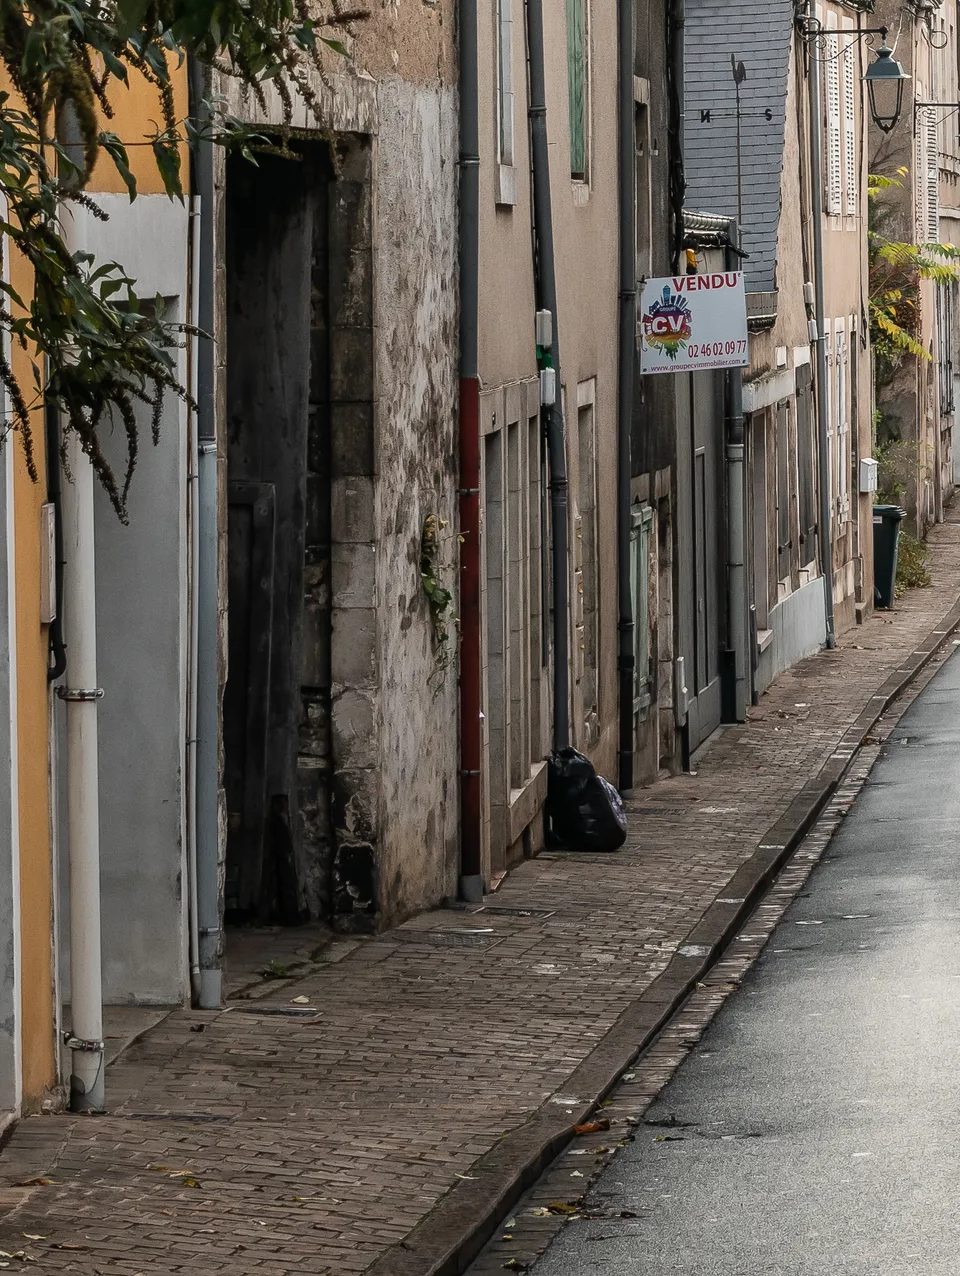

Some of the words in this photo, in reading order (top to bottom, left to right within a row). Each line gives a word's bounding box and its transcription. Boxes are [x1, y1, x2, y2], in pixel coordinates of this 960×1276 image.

[765, 108, 772, 121] S
[673, 273, 737, 292] VENDU
[652, 316, 684, 332] CV
[688, 345, 698, 358] 02
[701, 343, 711, 357] 46
[713, 342, 723, 356] 02
[725, 341, 735, 355] 09
[737, 340, 747, 353] 77
[651, 359, 740, 371] www.groupecvimmobilier.com
